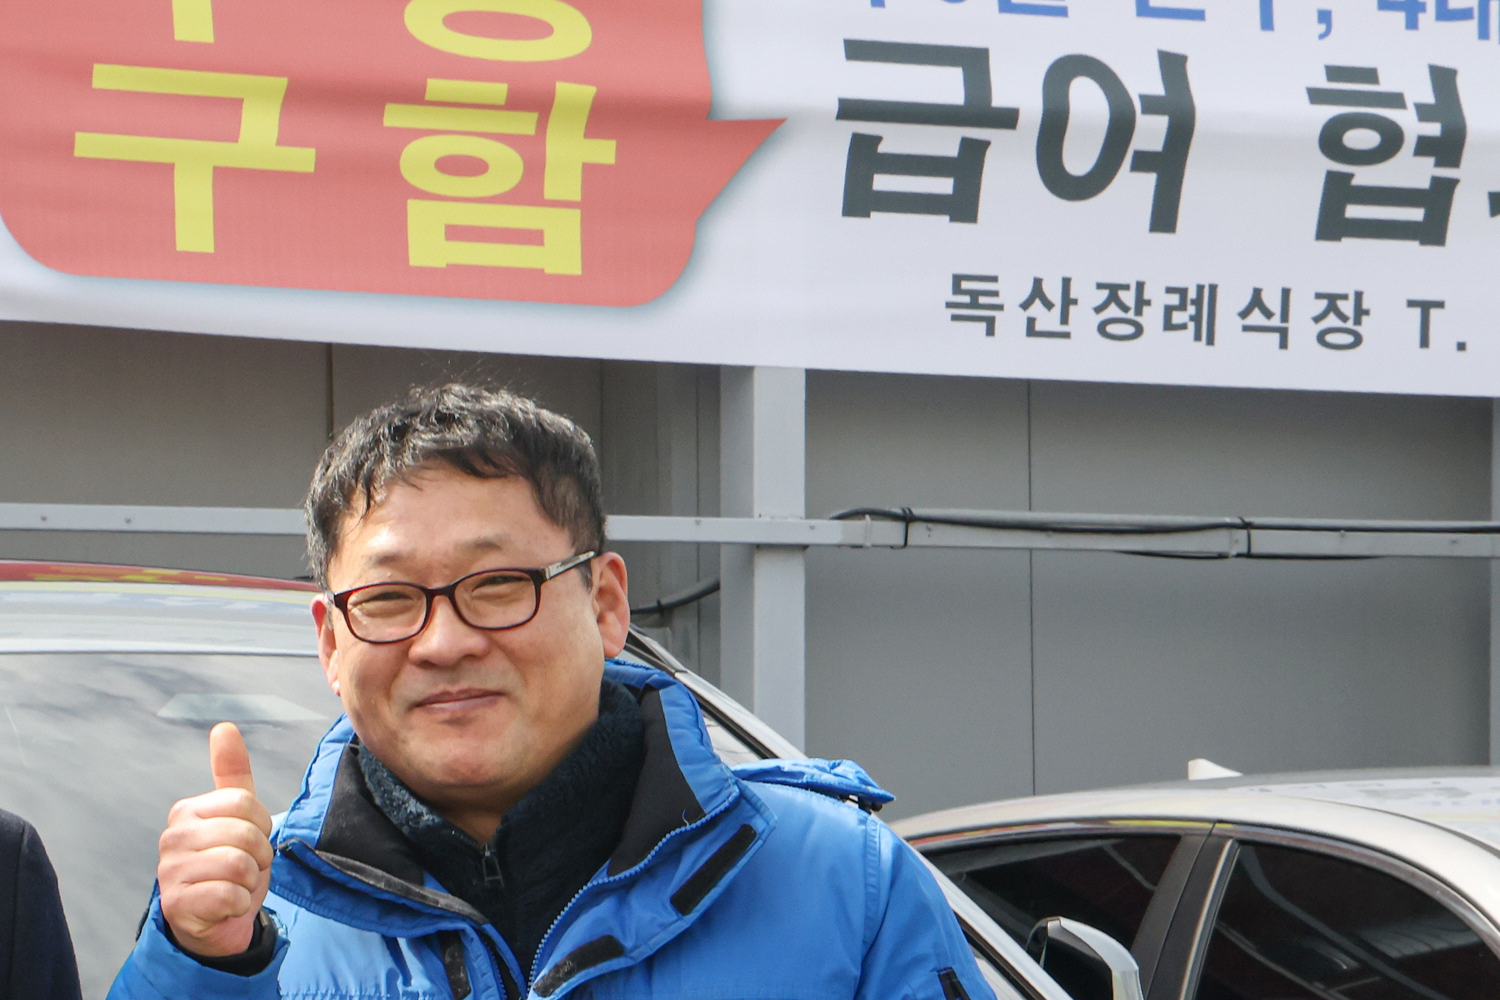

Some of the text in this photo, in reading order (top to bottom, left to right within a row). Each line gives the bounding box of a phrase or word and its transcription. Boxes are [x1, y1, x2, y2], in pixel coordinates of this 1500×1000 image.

[835, 38, 1500, 247] 급여 협
[945, 272, 1467, 352] 독산장례식장 T.
